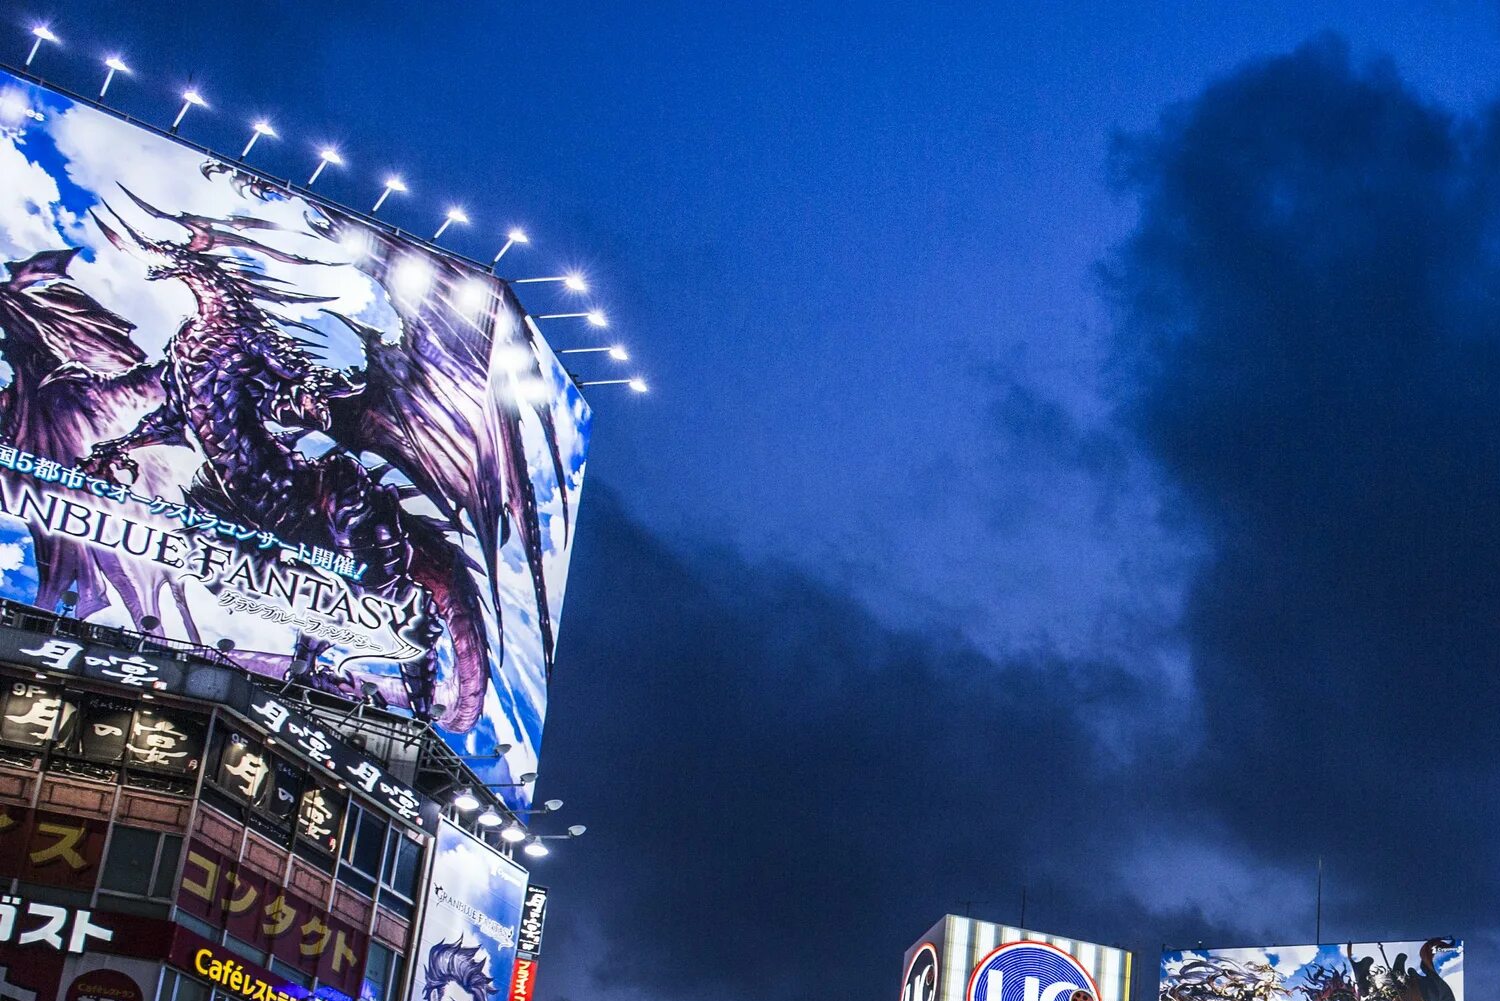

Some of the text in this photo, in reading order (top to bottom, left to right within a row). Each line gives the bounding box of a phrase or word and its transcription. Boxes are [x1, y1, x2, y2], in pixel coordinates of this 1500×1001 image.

[178, 538, 420, 650] FANTASY
[182, 849, 358, 972] コンタクト
